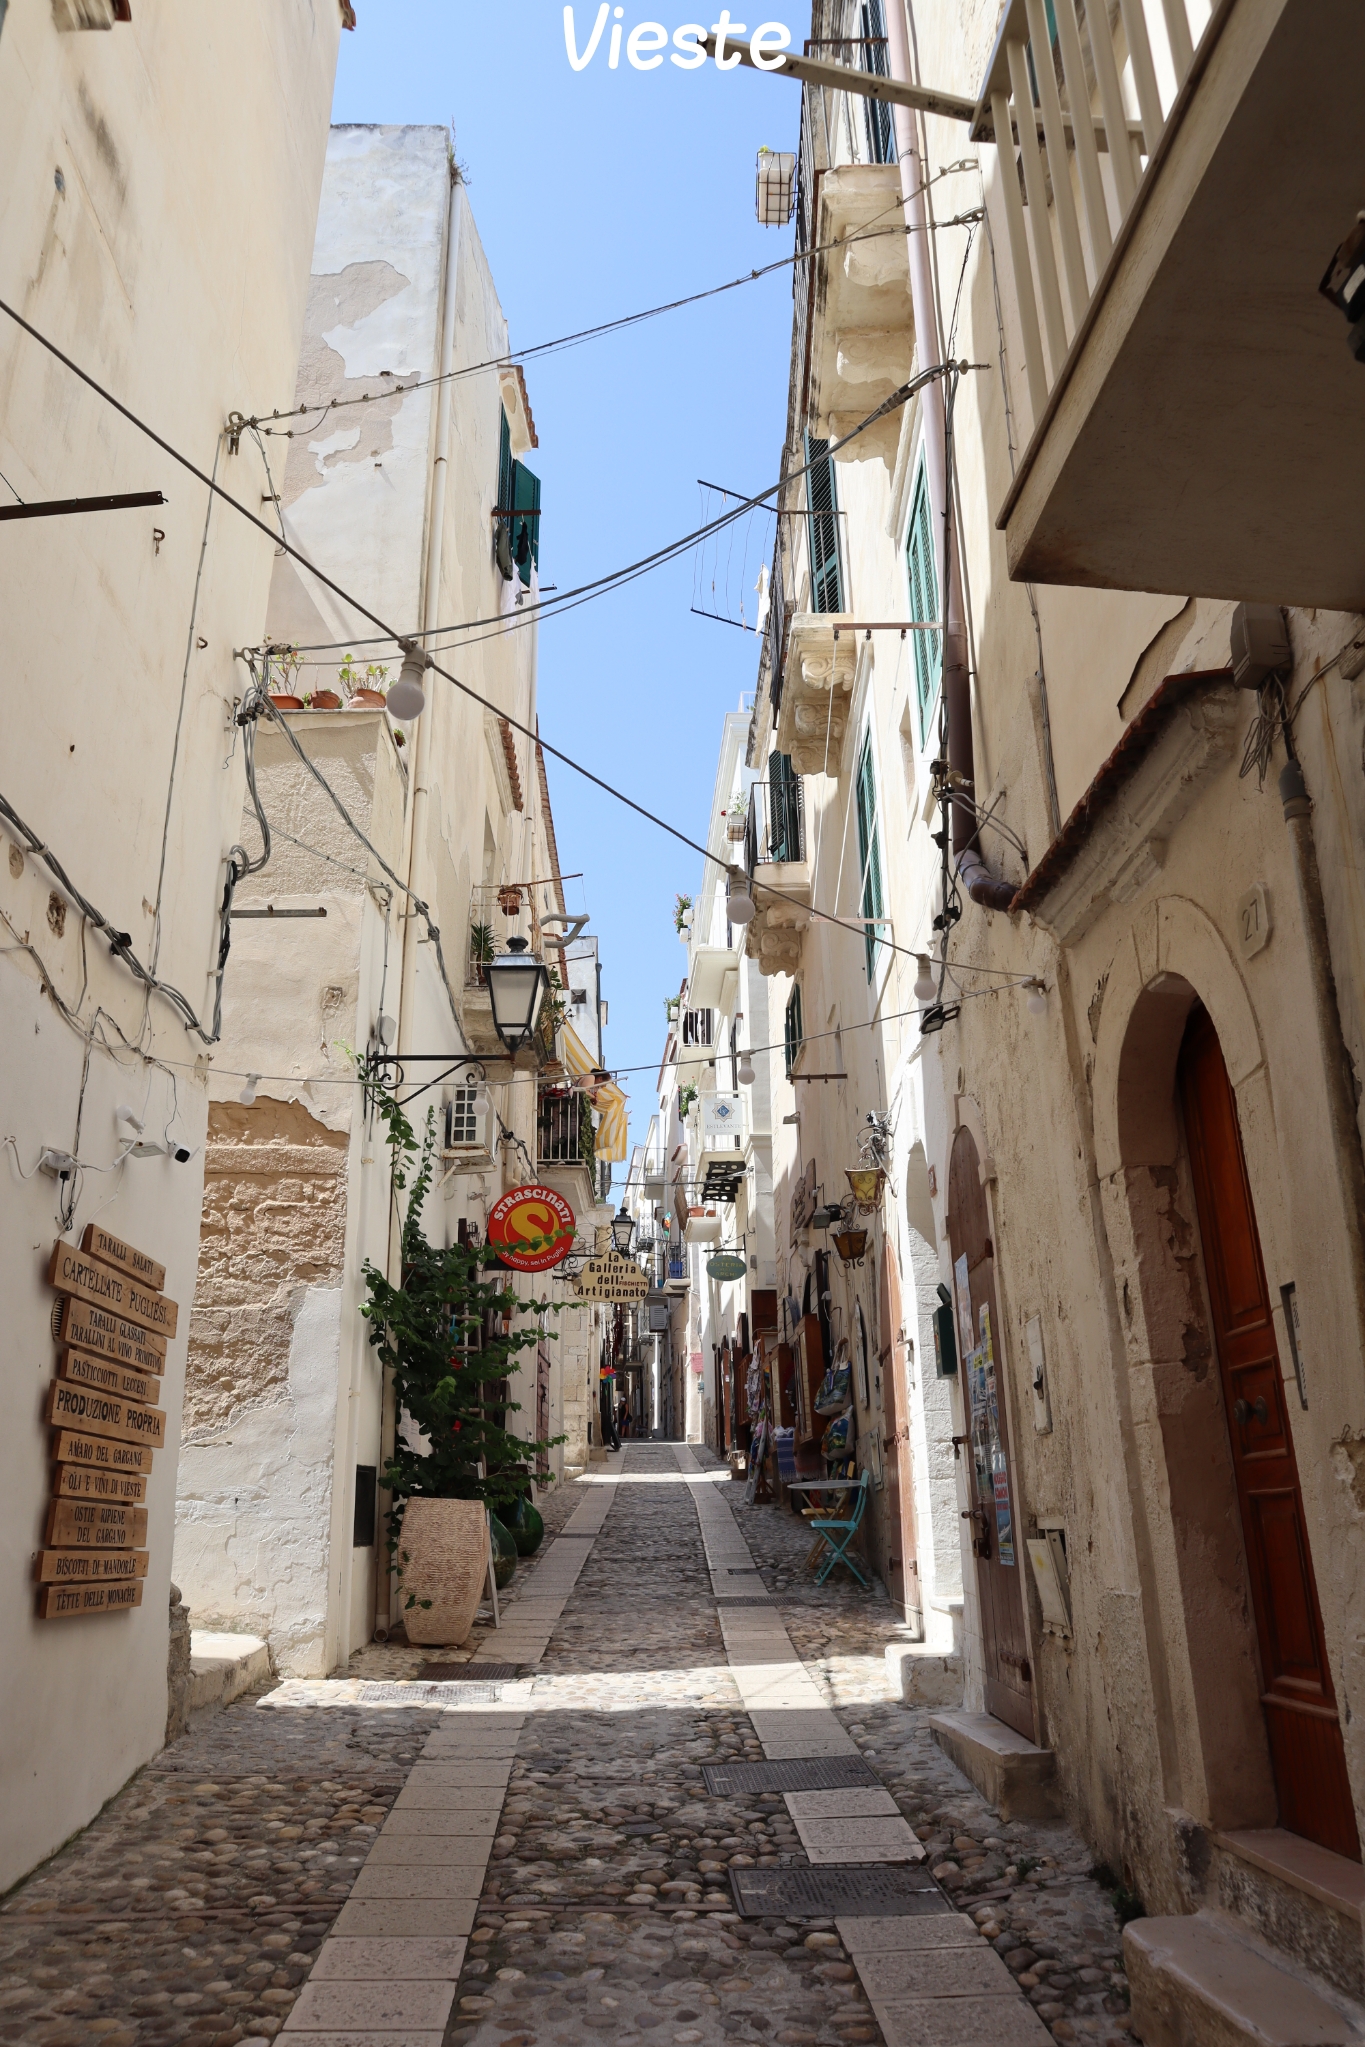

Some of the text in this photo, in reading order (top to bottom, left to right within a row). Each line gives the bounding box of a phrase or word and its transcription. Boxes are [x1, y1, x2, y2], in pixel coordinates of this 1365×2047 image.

[1242, 899, 1259, 941] 21
[494, 1189, 571, 1223] STRASCINATI
[98, 1233, 153, 1276] TARALLI SALATI
[547, 1246, 564, 1261] Puglia
[608, 1252, 619, 1262] La
[589, 1262, 636, 1274] Galleria
[597, 1275, 624, 1285] dell'
[63, 1257, 167, 1324] CARTELLATE PUGLIESI
[577, 1285, 646, 1298] Artigianato
[89, 1310, 146, 1346] TARALLI GLASSATI
[70, 1324, 105, 1350] TARALLINI
[108, 1337, 116, 1352] AL
[118, 1341, 132, 1358] VINO
[72, 1359, 147, 1396] PASTICCIOTTI LECCESI
[56, 1389, 160, 1436] PRODUZIONE PROPRIA
[68, 1440, 142, 1466] AMARO DEL GARGANO
[85, 1476, 90, 1491] E
[94, 1477, 108, 1494] VINI
[110, 1479, 118, 1495] DI
[120, 1480, 141, 1497] VIESTE
[74, 1505, 125, 1525] OSTIE RIPIENE
[77, 1527, 125, 1544] DEL GARGANO
[56, 1557, 136, 1576] BISCOTTI DI MANDORLE
[56, 1586, 135, 1611] TETTE DELLE MONACHE
